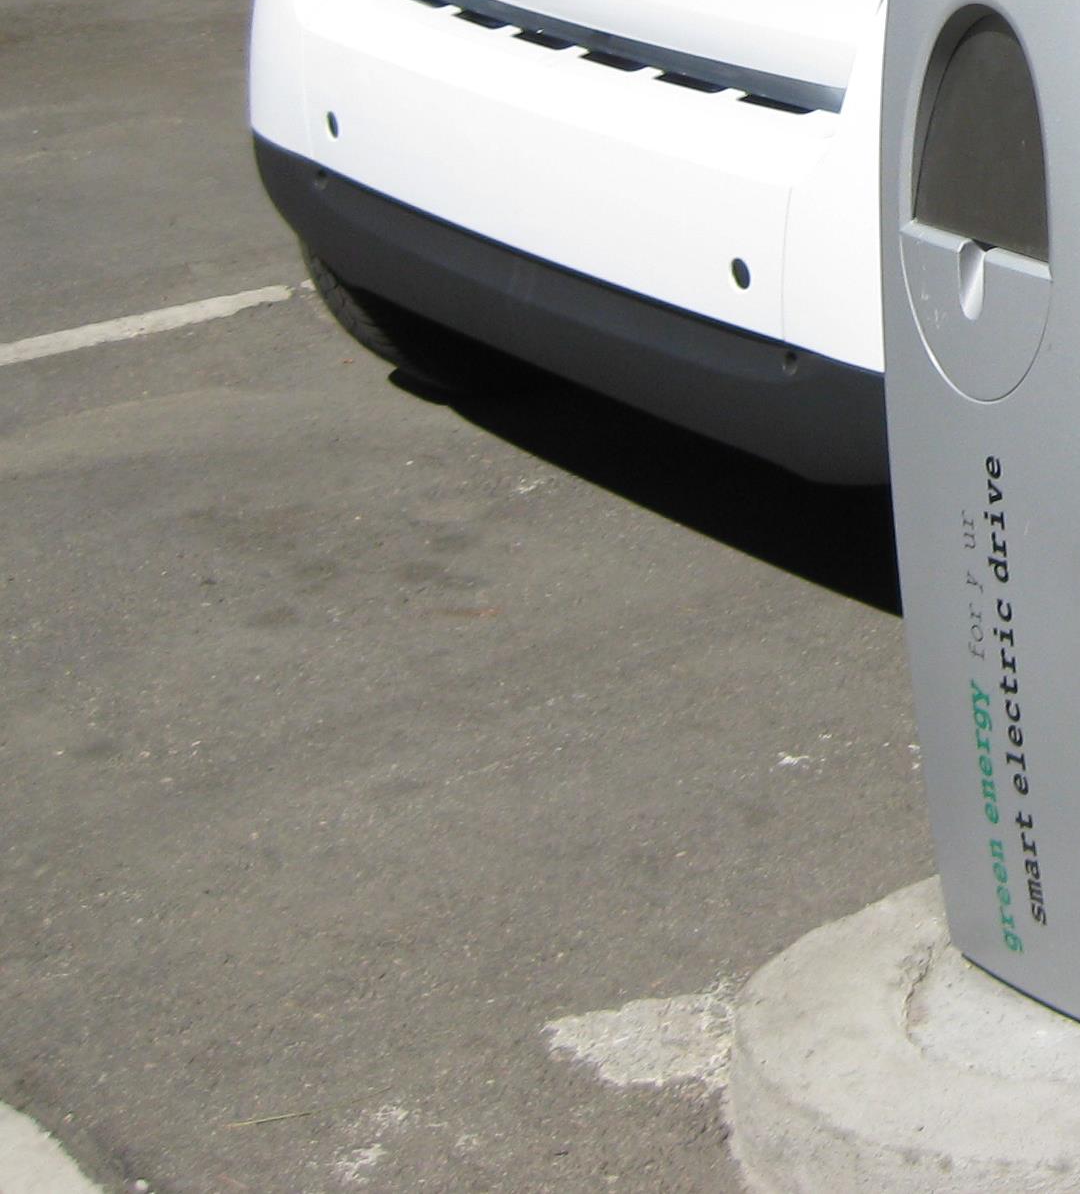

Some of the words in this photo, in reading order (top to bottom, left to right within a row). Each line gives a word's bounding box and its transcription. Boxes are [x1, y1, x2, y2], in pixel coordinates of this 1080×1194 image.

[962, 509, 984, 594] yur
[984, 456, 1010, 584] drive
[969, 603, 985, 661] for
[969, 678, 999, 825] energy
[993, 598, 1030, 796] electric
[989, 838, 1024, 954] green
[1014, 810, 1048, 926] smart
